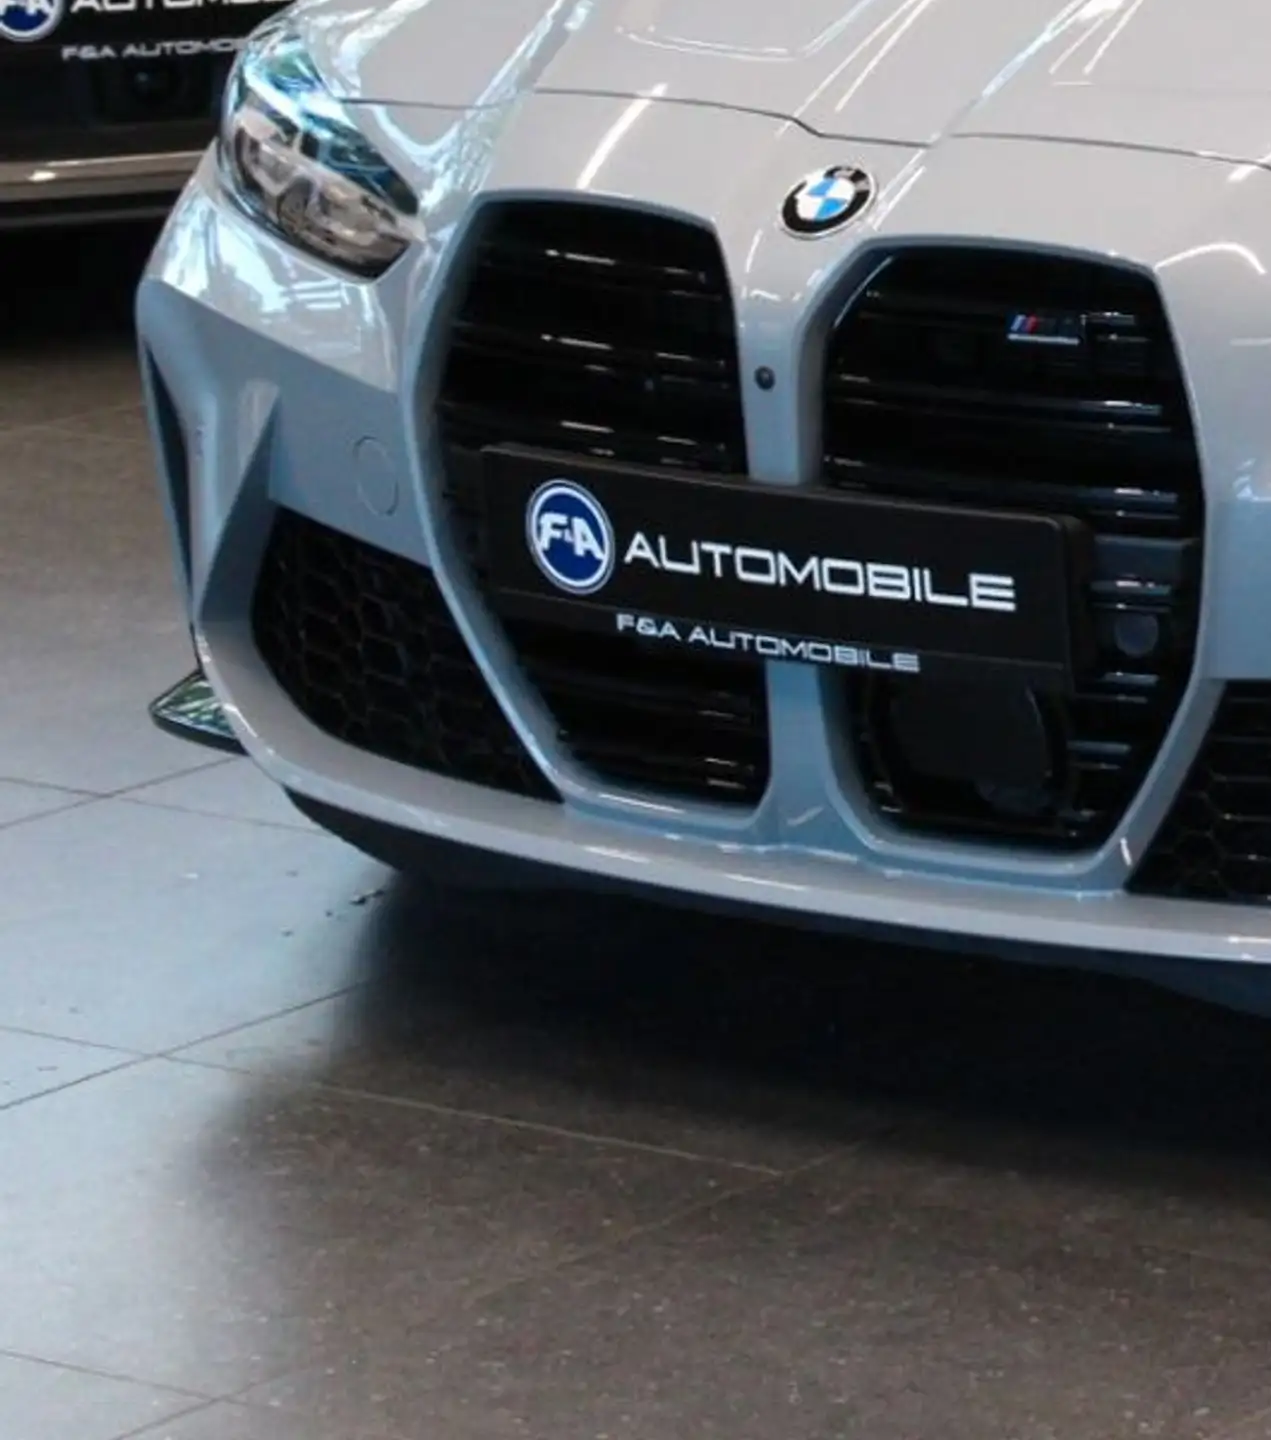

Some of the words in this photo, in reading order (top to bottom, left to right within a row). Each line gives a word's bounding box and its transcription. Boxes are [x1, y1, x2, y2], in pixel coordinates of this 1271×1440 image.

[624, 531, 1016, 611] AUTOMOBILE
[615, 612, 681, 641] F&A
[688, 624, 921, 673] AUTOMOBILE
